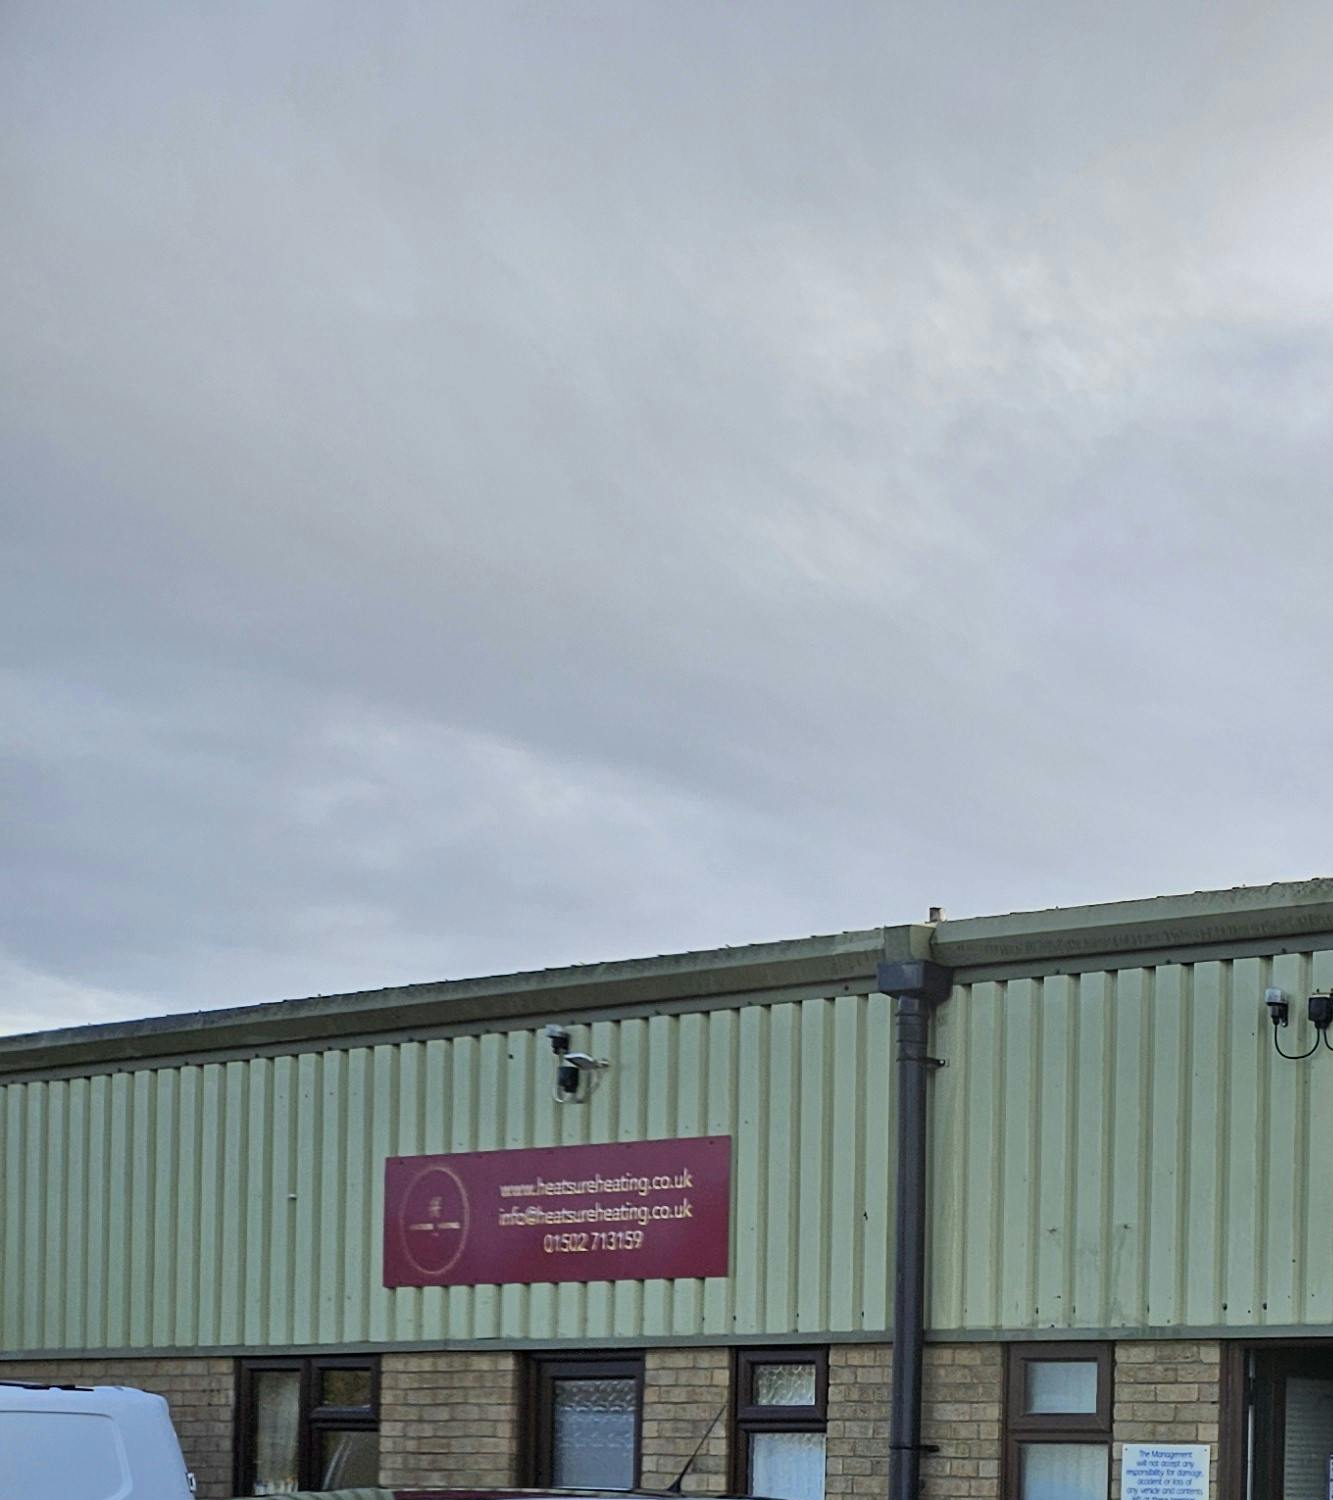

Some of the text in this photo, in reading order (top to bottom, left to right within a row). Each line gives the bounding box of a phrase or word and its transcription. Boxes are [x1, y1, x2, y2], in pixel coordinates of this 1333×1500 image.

[499, 1168, 692, 1196] www.heatsureheating.co.uk
[498, 1198, 692, 1226] info@heatsureheating.co.uk
[544, 1230, 644, 1252] 01502 713159
